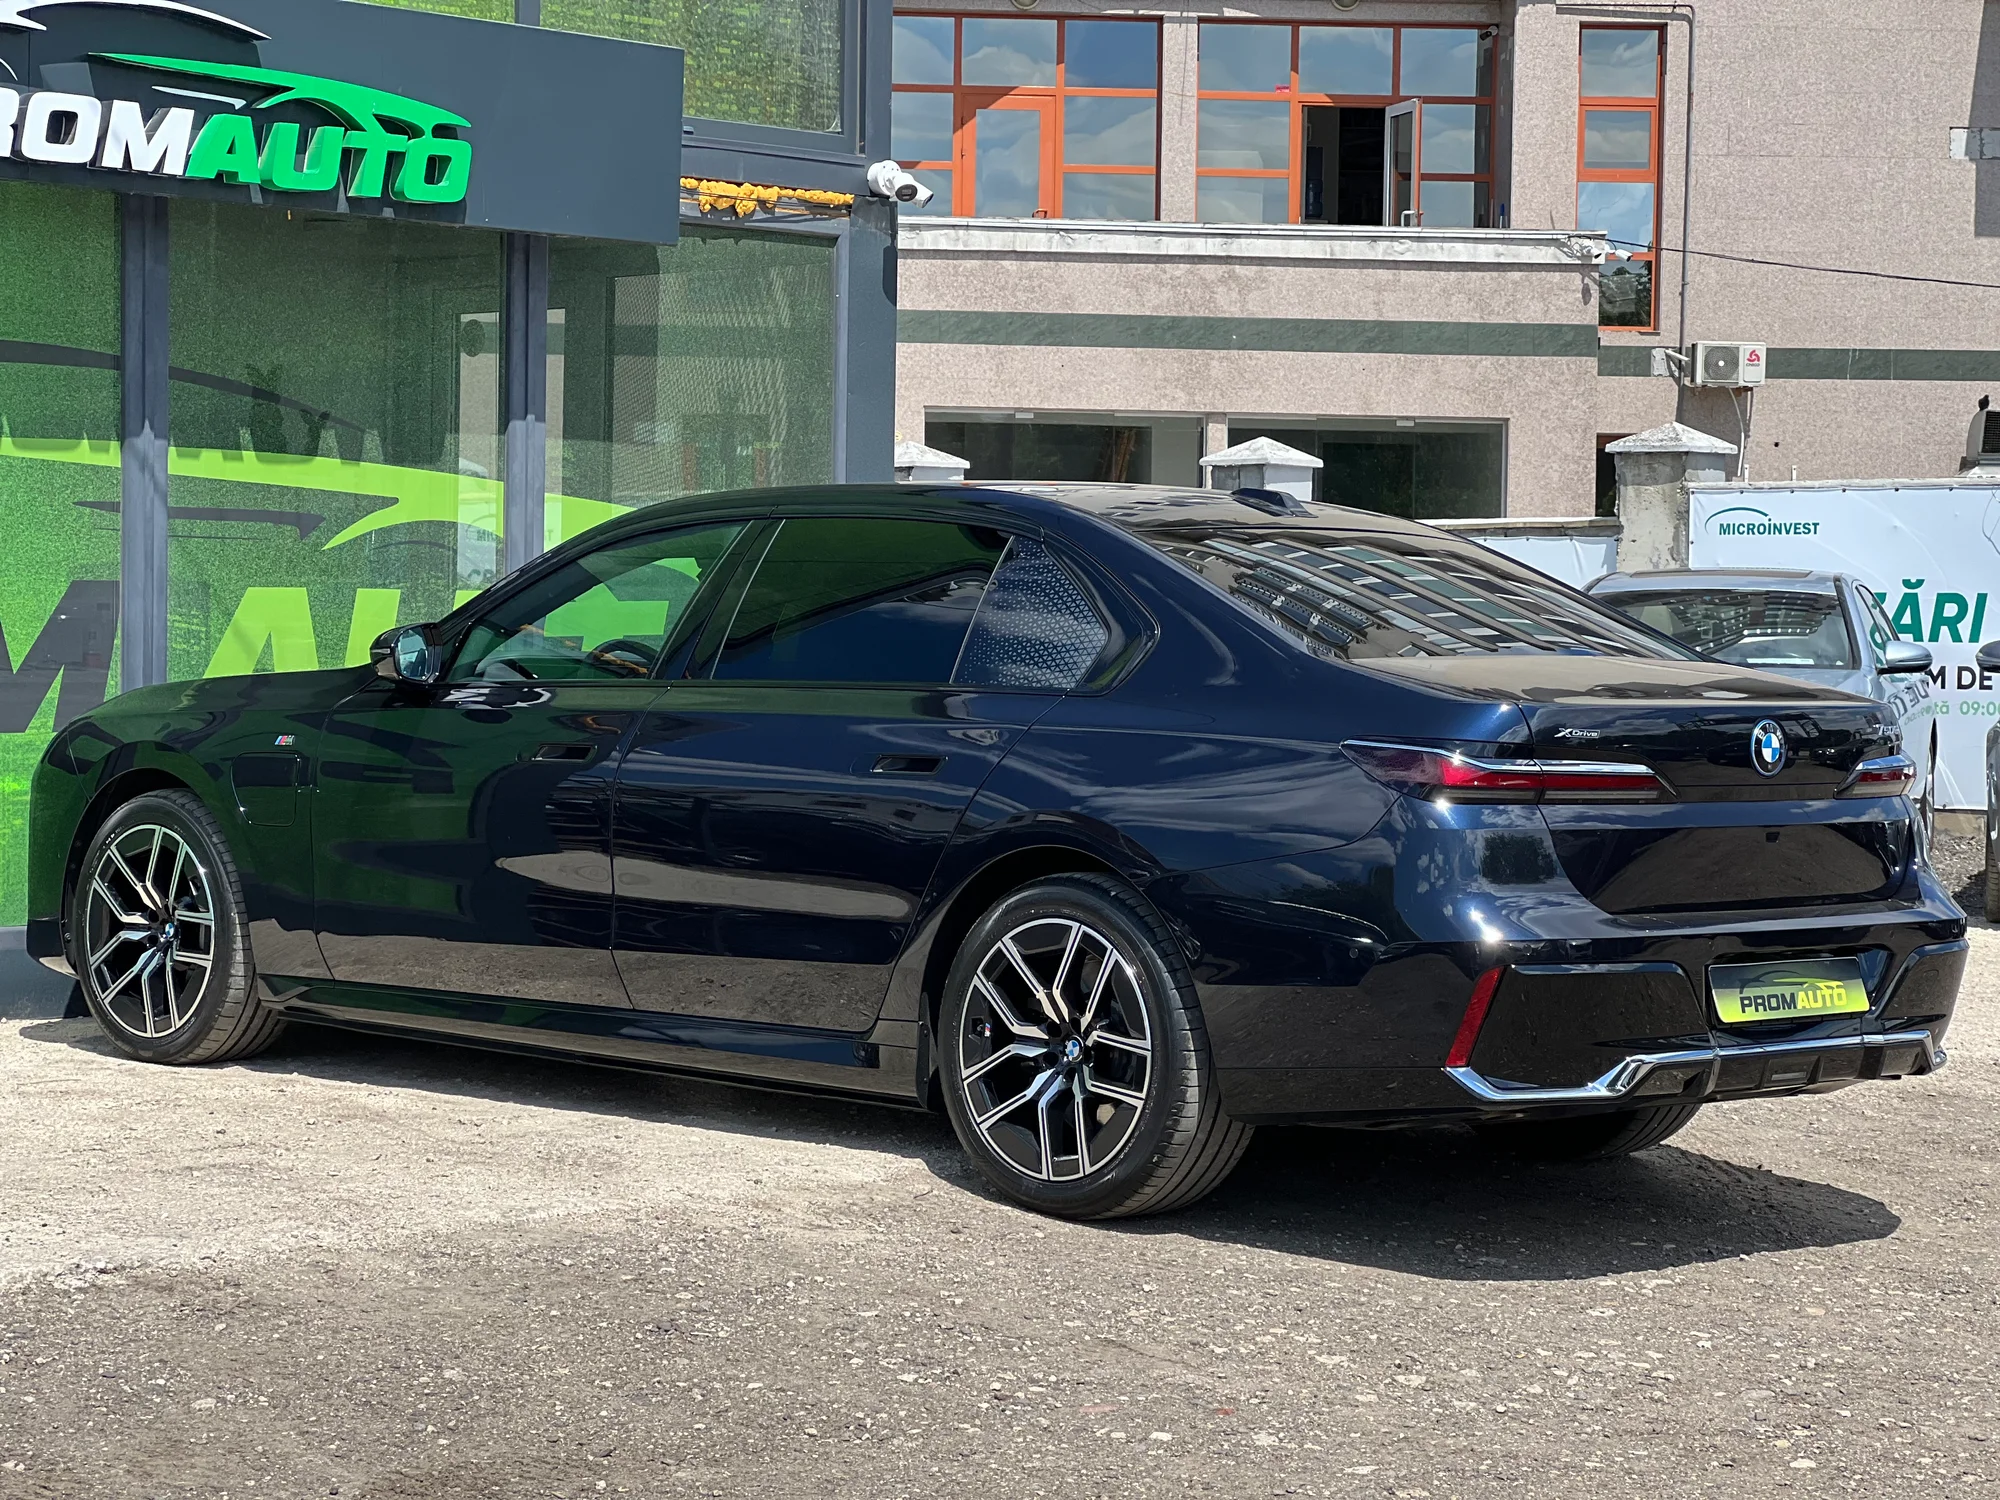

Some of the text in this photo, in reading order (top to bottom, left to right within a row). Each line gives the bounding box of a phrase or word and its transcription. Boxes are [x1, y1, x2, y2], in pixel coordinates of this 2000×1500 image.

[0, 87, 472, 204] OMAUTO
[1873, 578, 1988, 643] ĂRI
[1956, 665, 1993, 690] DE
[1934, 700, 2000, 716] tă 09:0
[1740, 988, 1847, 1013] PROMAUTO
